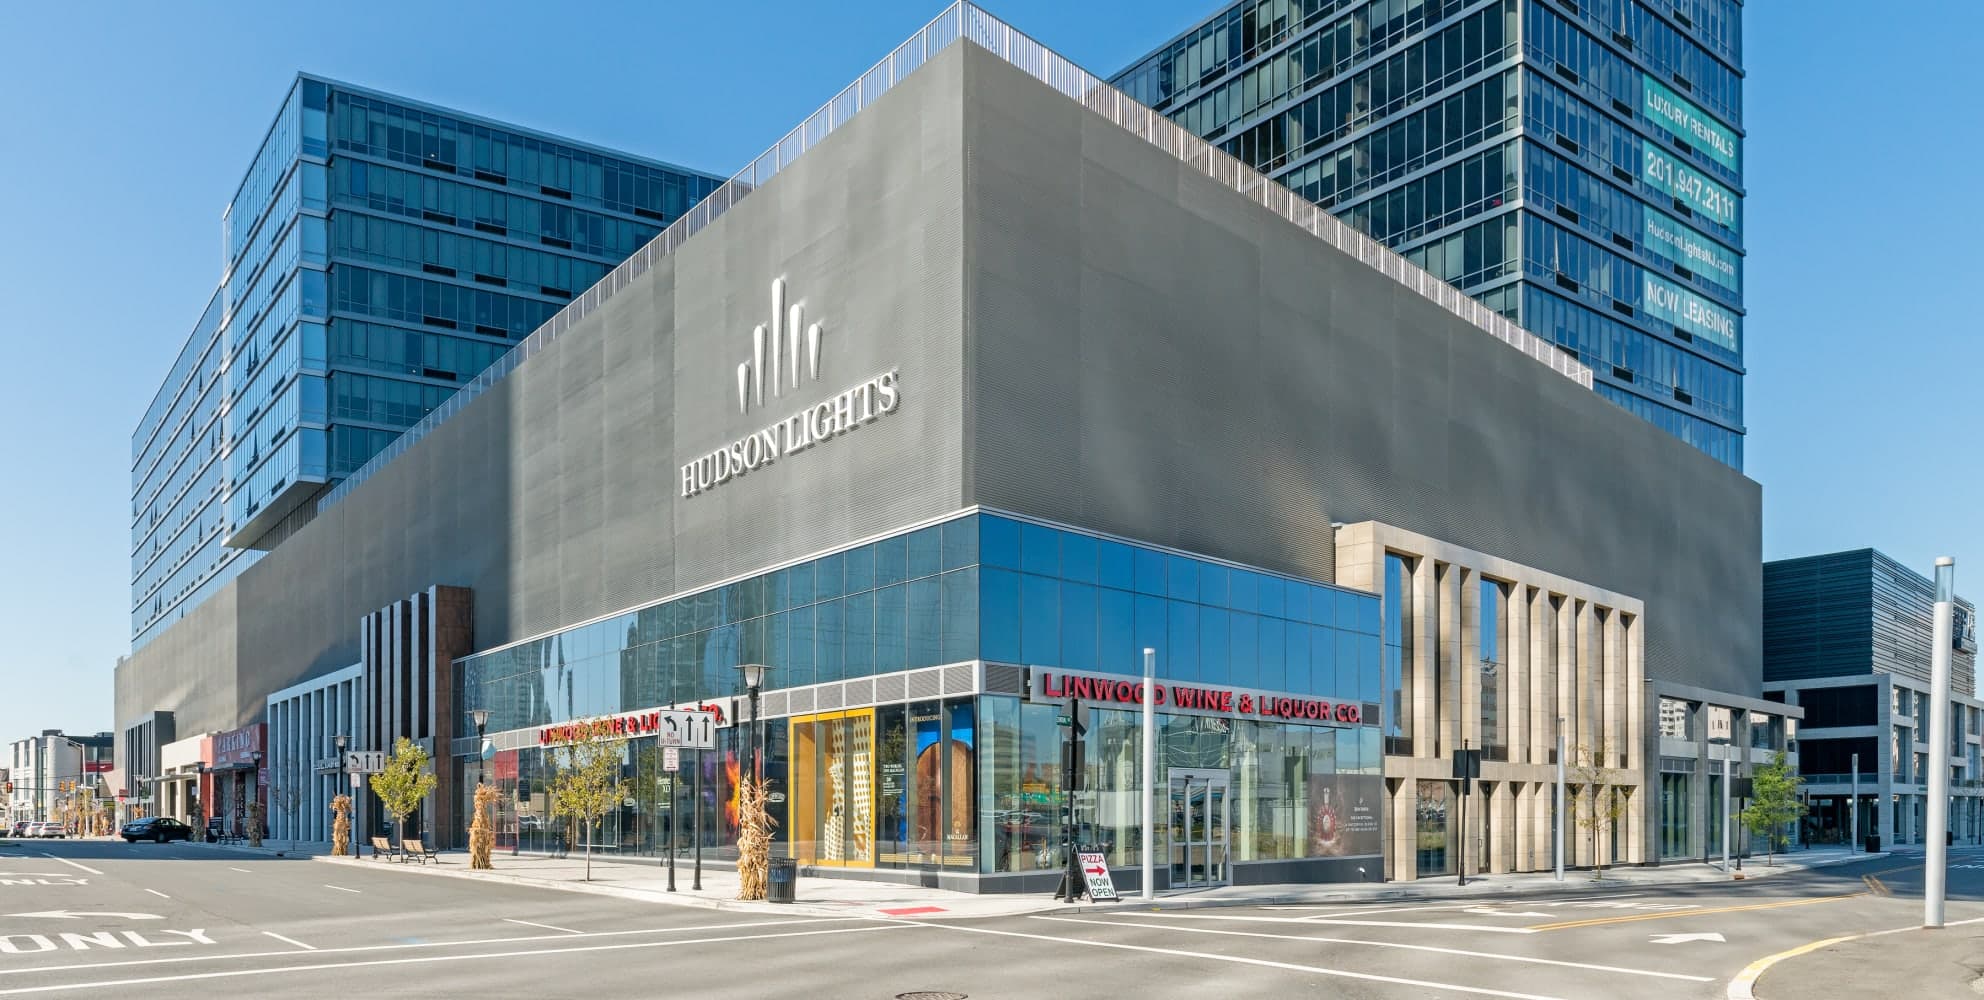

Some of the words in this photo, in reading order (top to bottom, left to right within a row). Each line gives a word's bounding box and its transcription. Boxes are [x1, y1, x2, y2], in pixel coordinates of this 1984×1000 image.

[1647, 89, 1688, 129] LUXURY
[1691, 117, 1734, 158] RENTALS
[1647, 151, 1734, 222] 201.947.2111
[1647, 219, 1734, 276] HudsonLightsNJ.com
[1647, 281, 1679, 313] NOW
[1683, 296, 1734, 339] LEASING
[681, 424, 784, 497] HUDSON
[784, 368, 899, 454] LIGHTS
[1044, 673, 1167, 705] LINWOOD
[1173, 687, 1232, 713] WINE
[1239, 693, 1254, 714] &
[1259, 695, 1331, 720] LIQUOR
[1335, 703, 1361, 723] CO.
[626, 715, 638, 733] &
[1081, 854, 1104, 864] PIZZA
[1089, 878, 1109, 887] NOW
[1092, 888, 1115, 896] OPEN
[0, 928, 217, 953] ONLY
